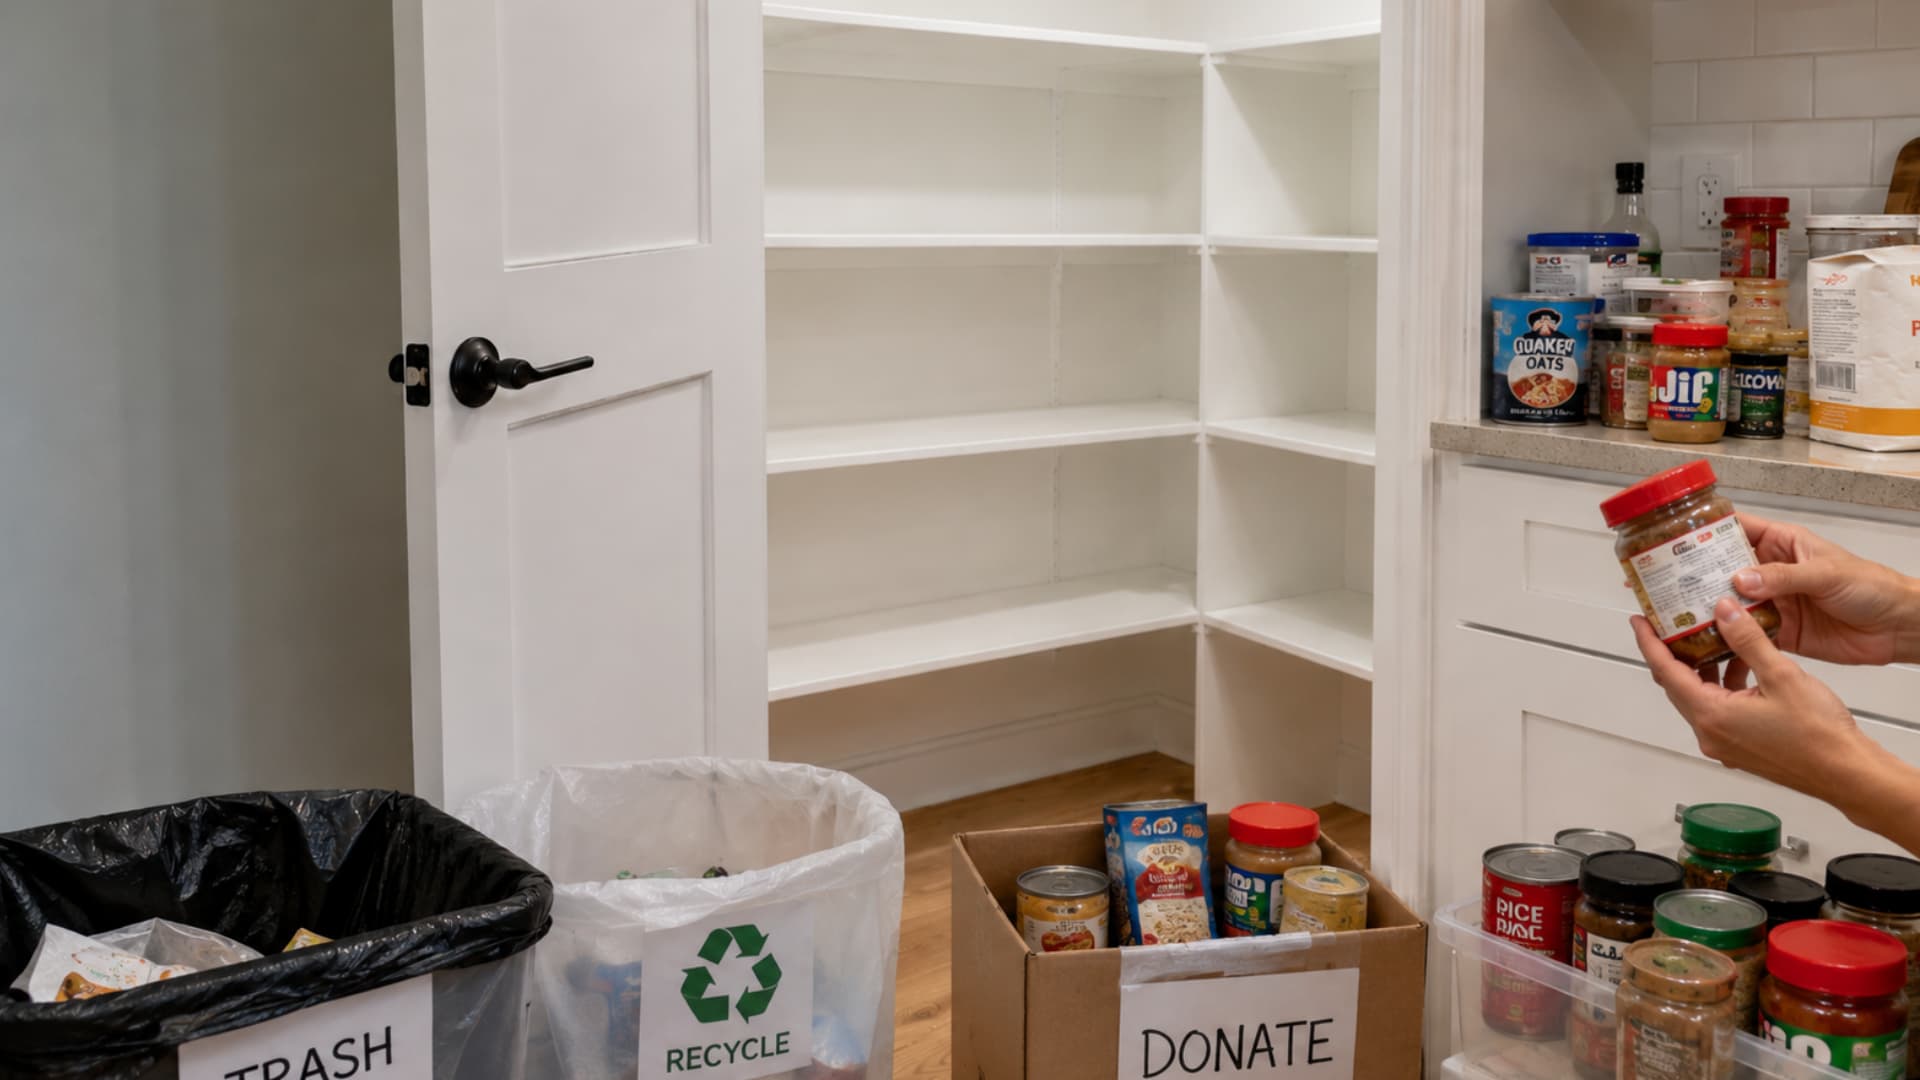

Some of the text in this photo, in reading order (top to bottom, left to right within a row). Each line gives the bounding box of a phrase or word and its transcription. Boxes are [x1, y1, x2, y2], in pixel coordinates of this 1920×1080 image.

[1526, 357, 1564, 371] OATS
[1658, 370, 1714, 403] Jif
[666, 1031, 790, 1073] RECYCLE
[1142, 1018, 1334, 1078] DONATE
